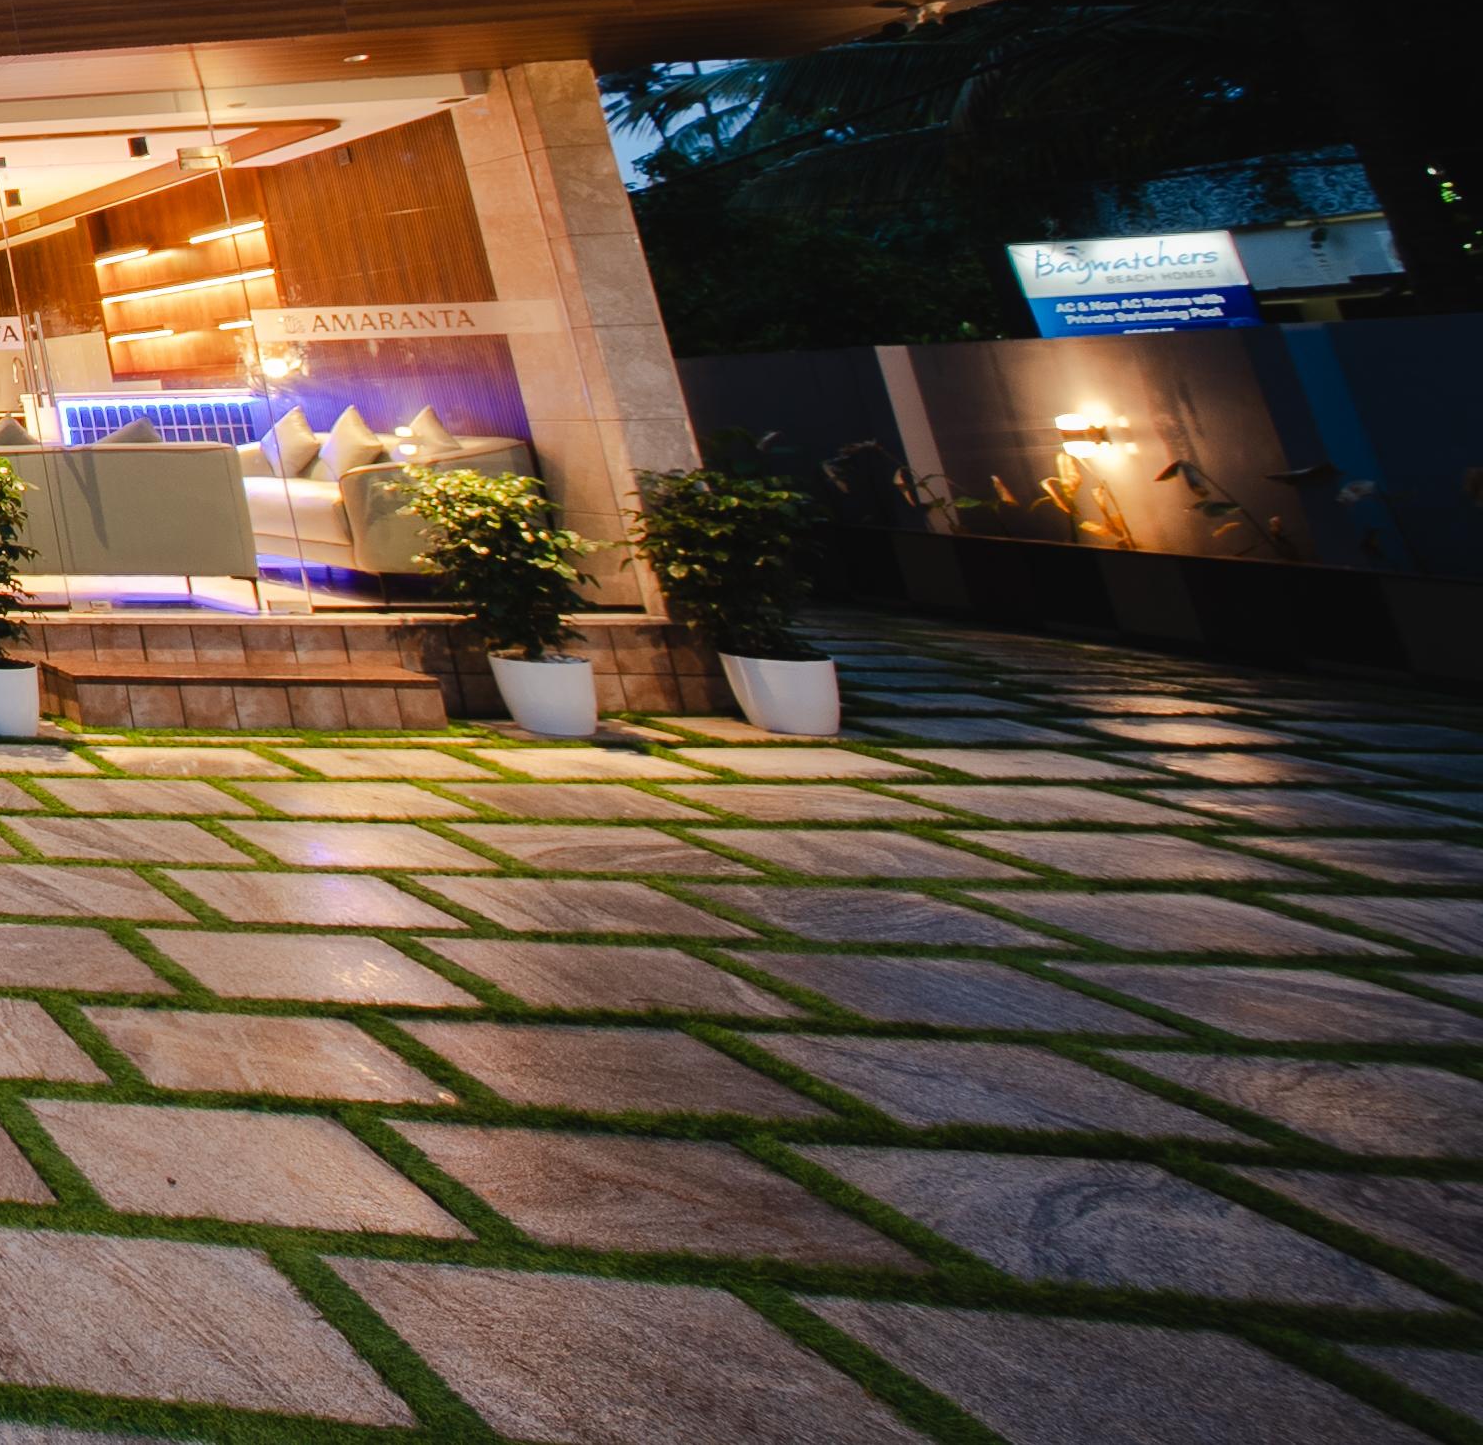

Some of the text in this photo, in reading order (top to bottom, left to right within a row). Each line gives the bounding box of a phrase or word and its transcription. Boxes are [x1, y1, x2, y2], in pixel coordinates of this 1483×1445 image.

[1035, 241, 1219, 284] Baywatchers
[1105, 269, 1216, 284] BEACH HOMES
[1055, 303, 1078, 313] AC
[1093, 299, 1119, 311] Non
[1121, 298, 1142, 309] AC
[1144, 296, 1192, 307] Rooms
[1193, 293, 1225, 305] with
[312, 309, 476, 333] AMARANTA
[1065, 306, 1224, 325] Private Swimming Pool
